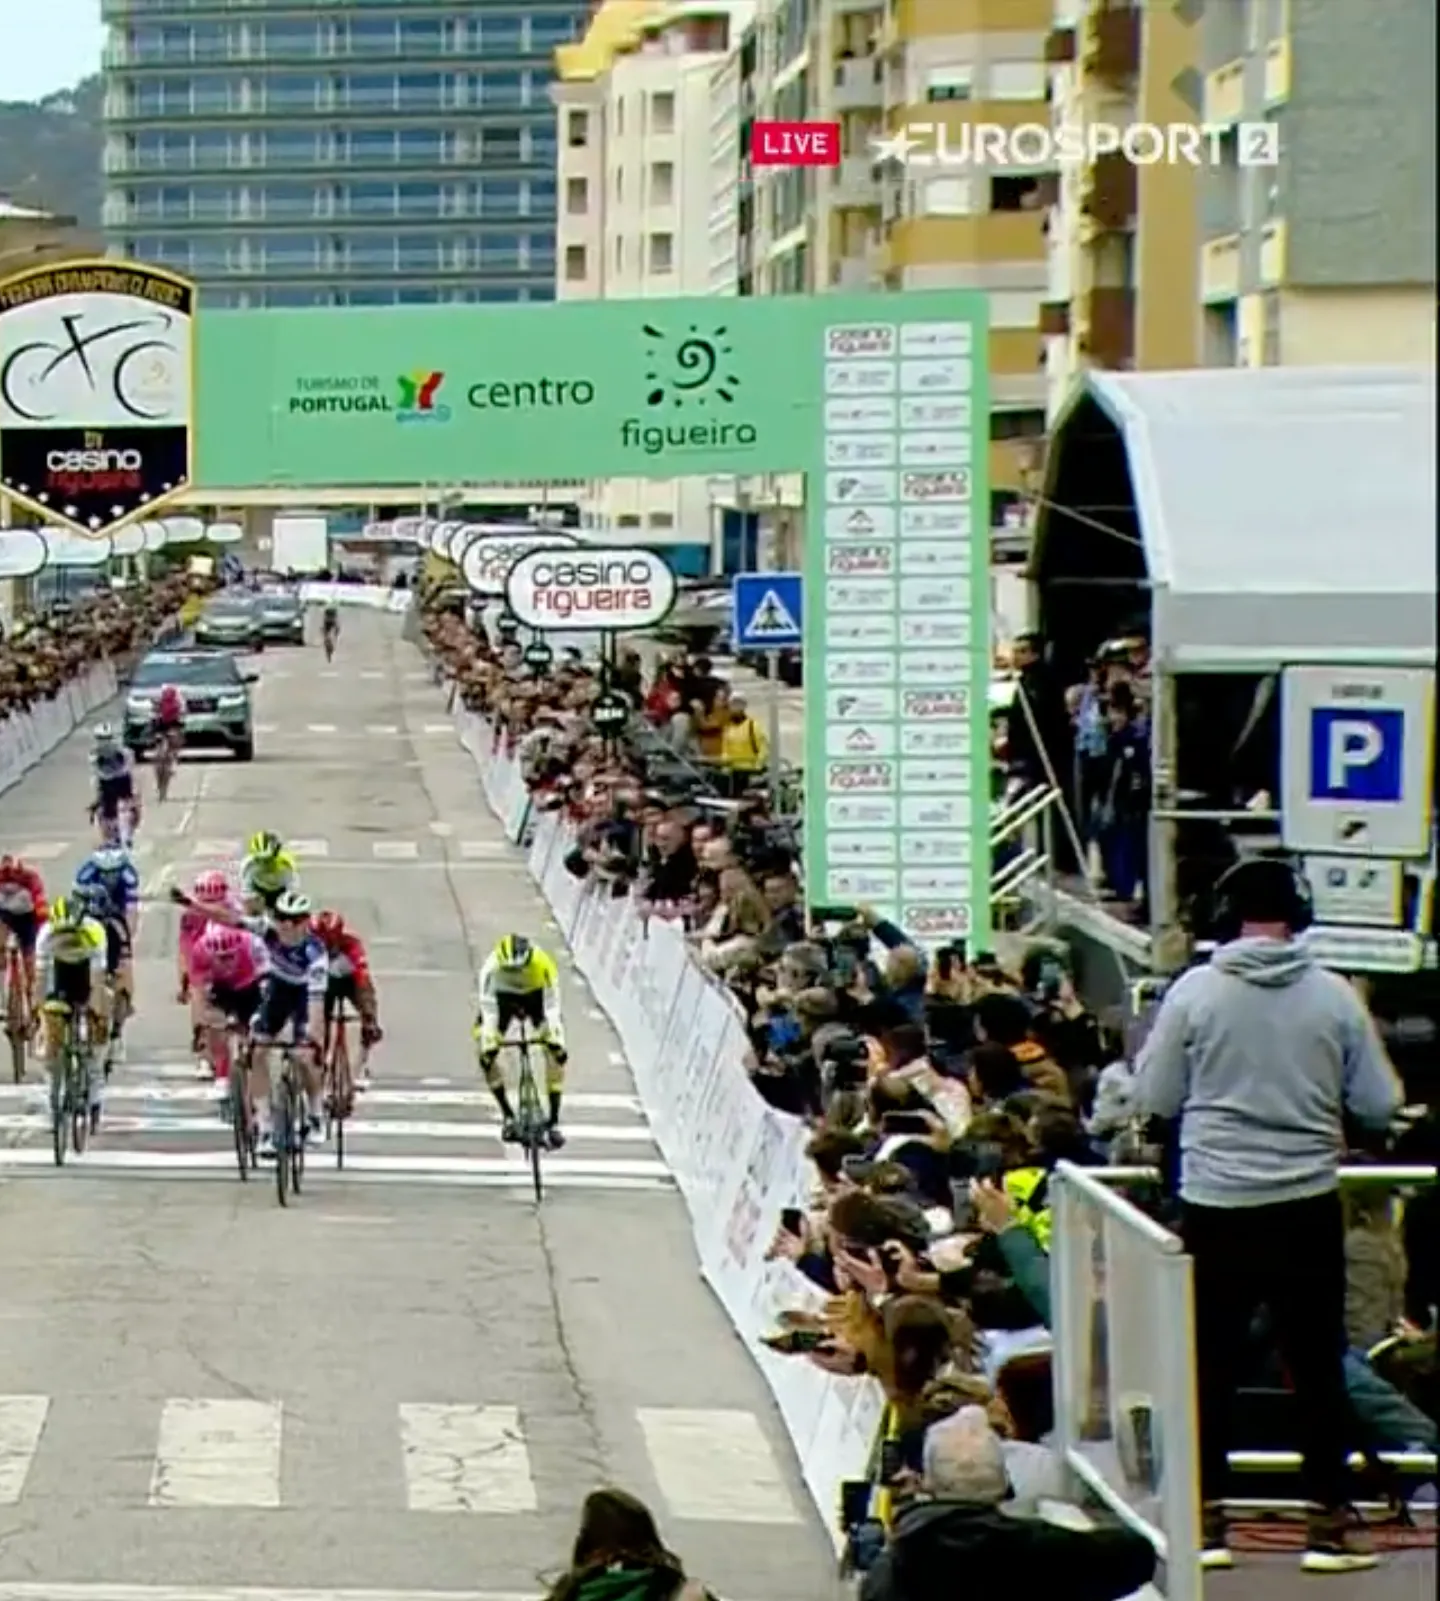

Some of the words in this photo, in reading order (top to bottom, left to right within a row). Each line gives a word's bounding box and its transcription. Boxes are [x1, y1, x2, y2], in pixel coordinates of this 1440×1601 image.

[296, 377, 358, 392] TURISMO
[361, 375, 380, 390] DE
[467, 376, 595, 408] centro
[289, 395, 393, 413] PORTUGAL
[621, 418, 757, 454] figueira
[46, 449, 143, 472] casino
[532, 560, 652, 588] casino
[532, 587, 652, 619] figueira
[1327, 719, 1384, 789] P
